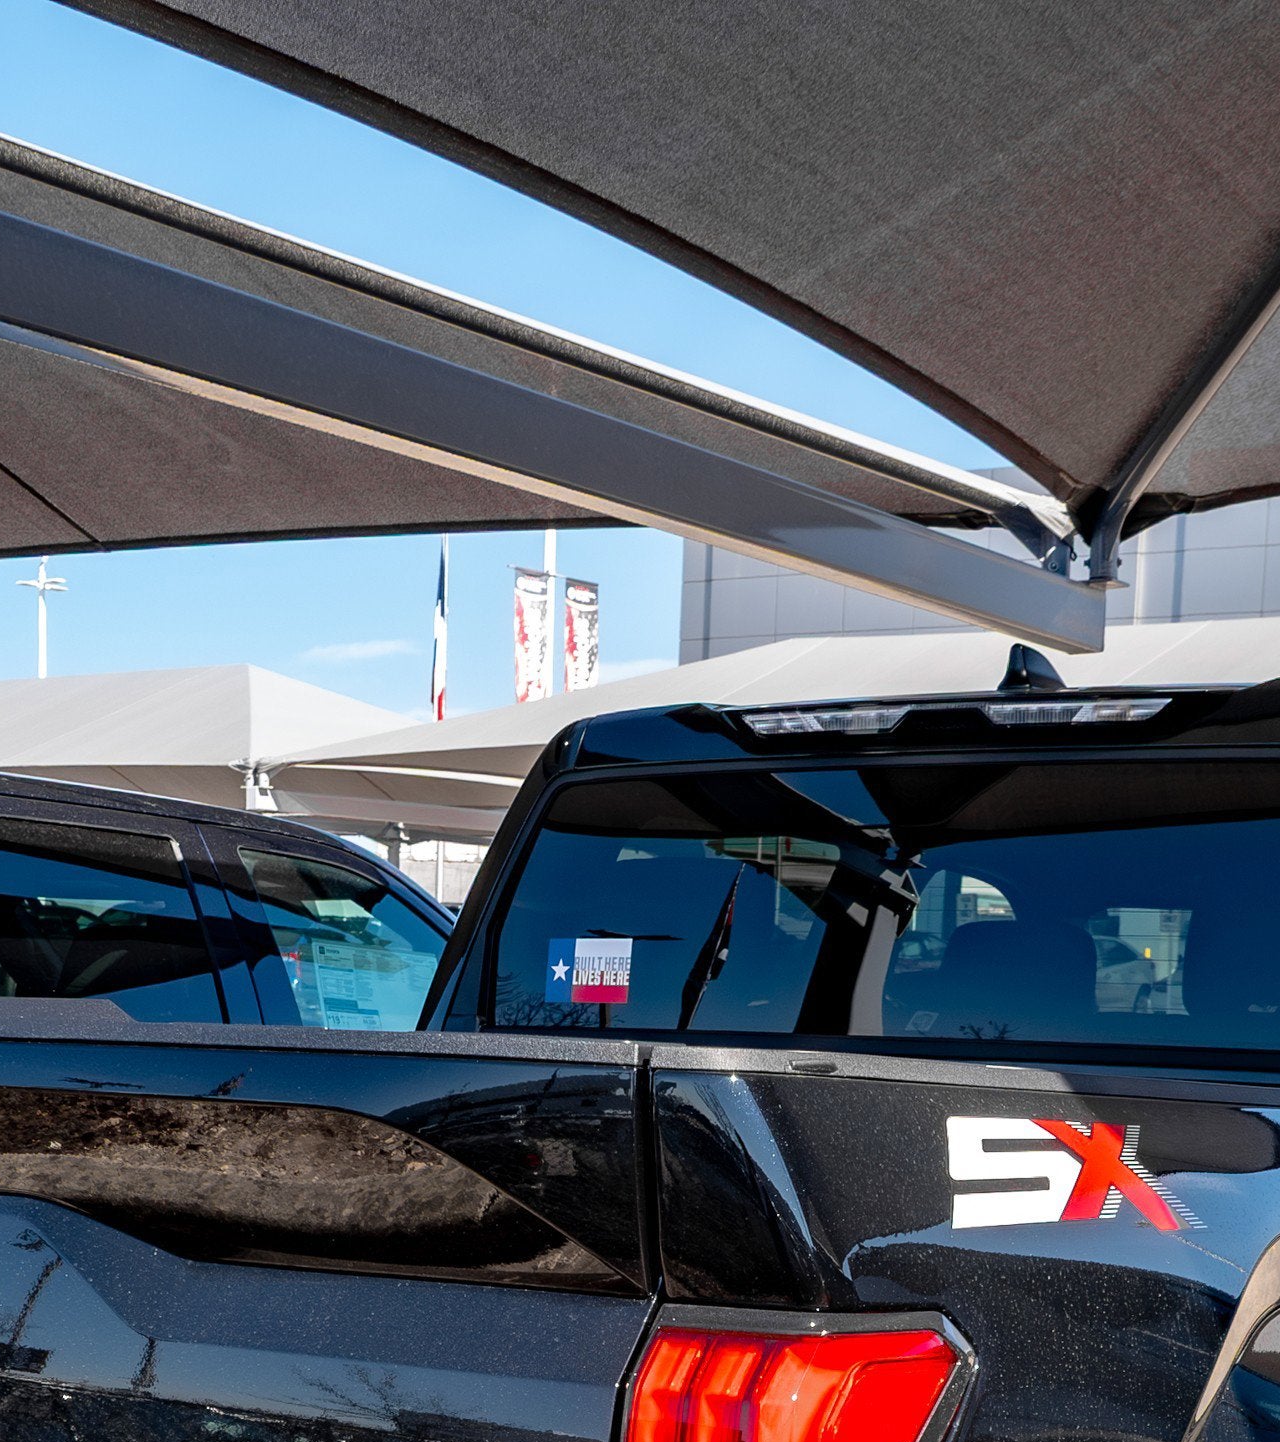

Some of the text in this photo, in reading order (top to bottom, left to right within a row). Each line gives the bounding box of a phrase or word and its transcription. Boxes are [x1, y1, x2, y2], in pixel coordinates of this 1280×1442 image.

[575, 957, 631, 971] BUILT HERE
[572, 971, 630, 986] LIVES HERE
